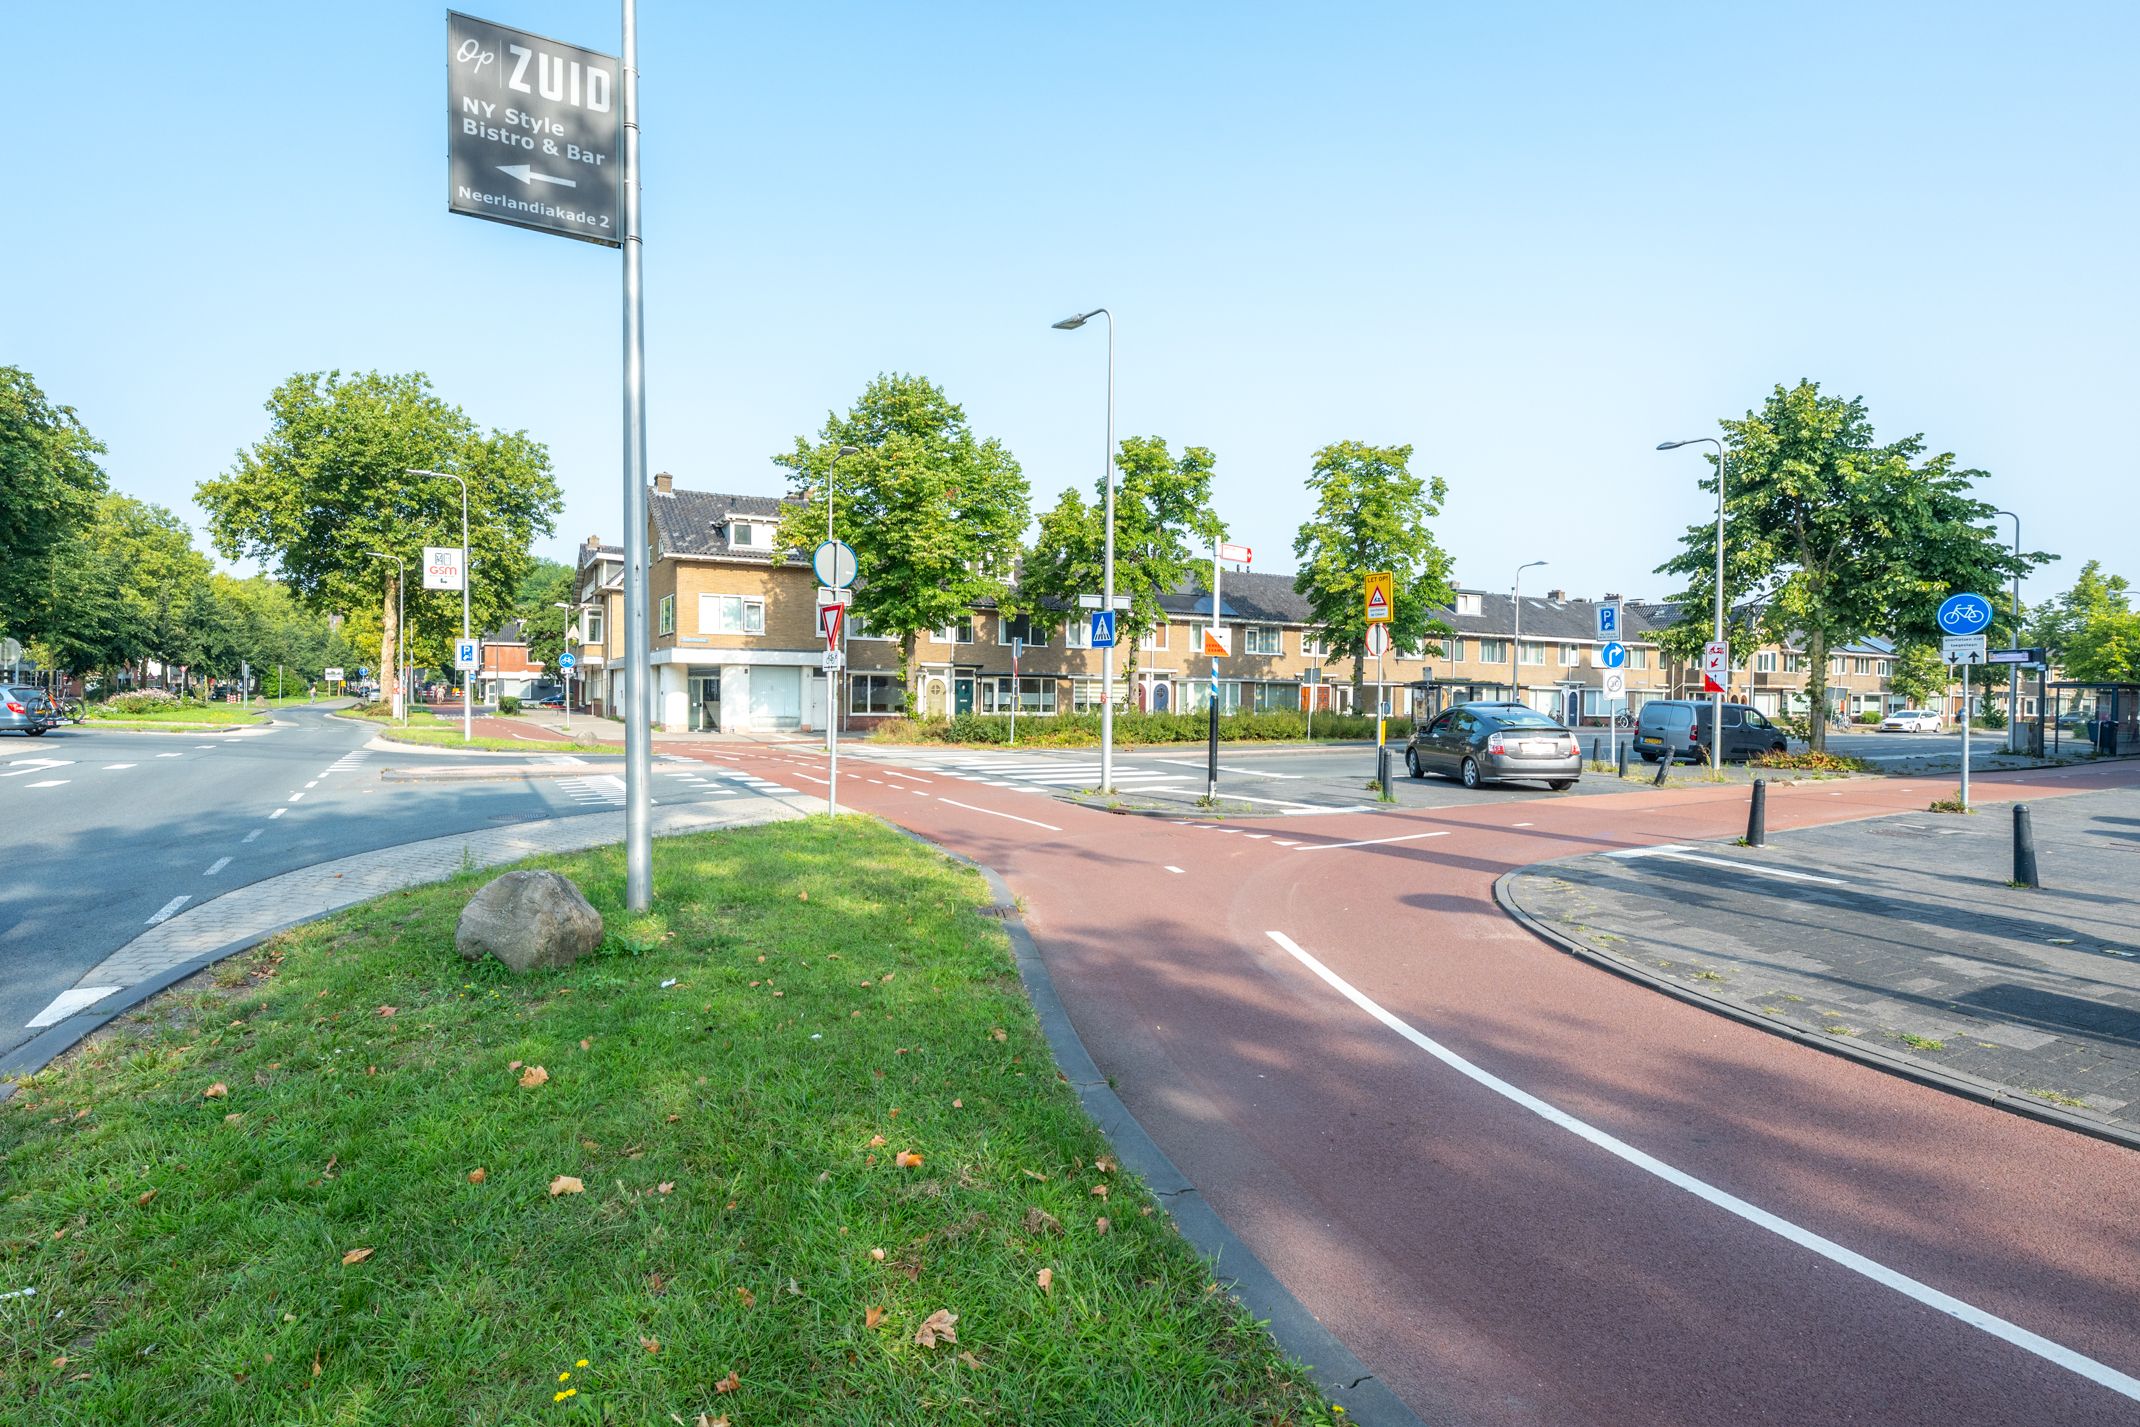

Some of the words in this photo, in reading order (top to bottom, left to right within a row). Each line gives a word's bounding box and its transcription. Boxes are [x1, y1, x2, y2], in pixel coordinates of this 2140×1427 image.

[456, 38, 495, 74] Op
[508, 43, 611, 114] ZUID
[462, 96, 497, 119] NY
[504, 107, 565, 137] Style
[462, 118, 535, 151] Bistro
[541, 138, 560, 157] &
[567, 143, 606, 166] Bar
[458, 185, 596, 226] Neerlandiakade
[599, 215, 610, 229] 2
[429, 565, 457, 576] GSM
